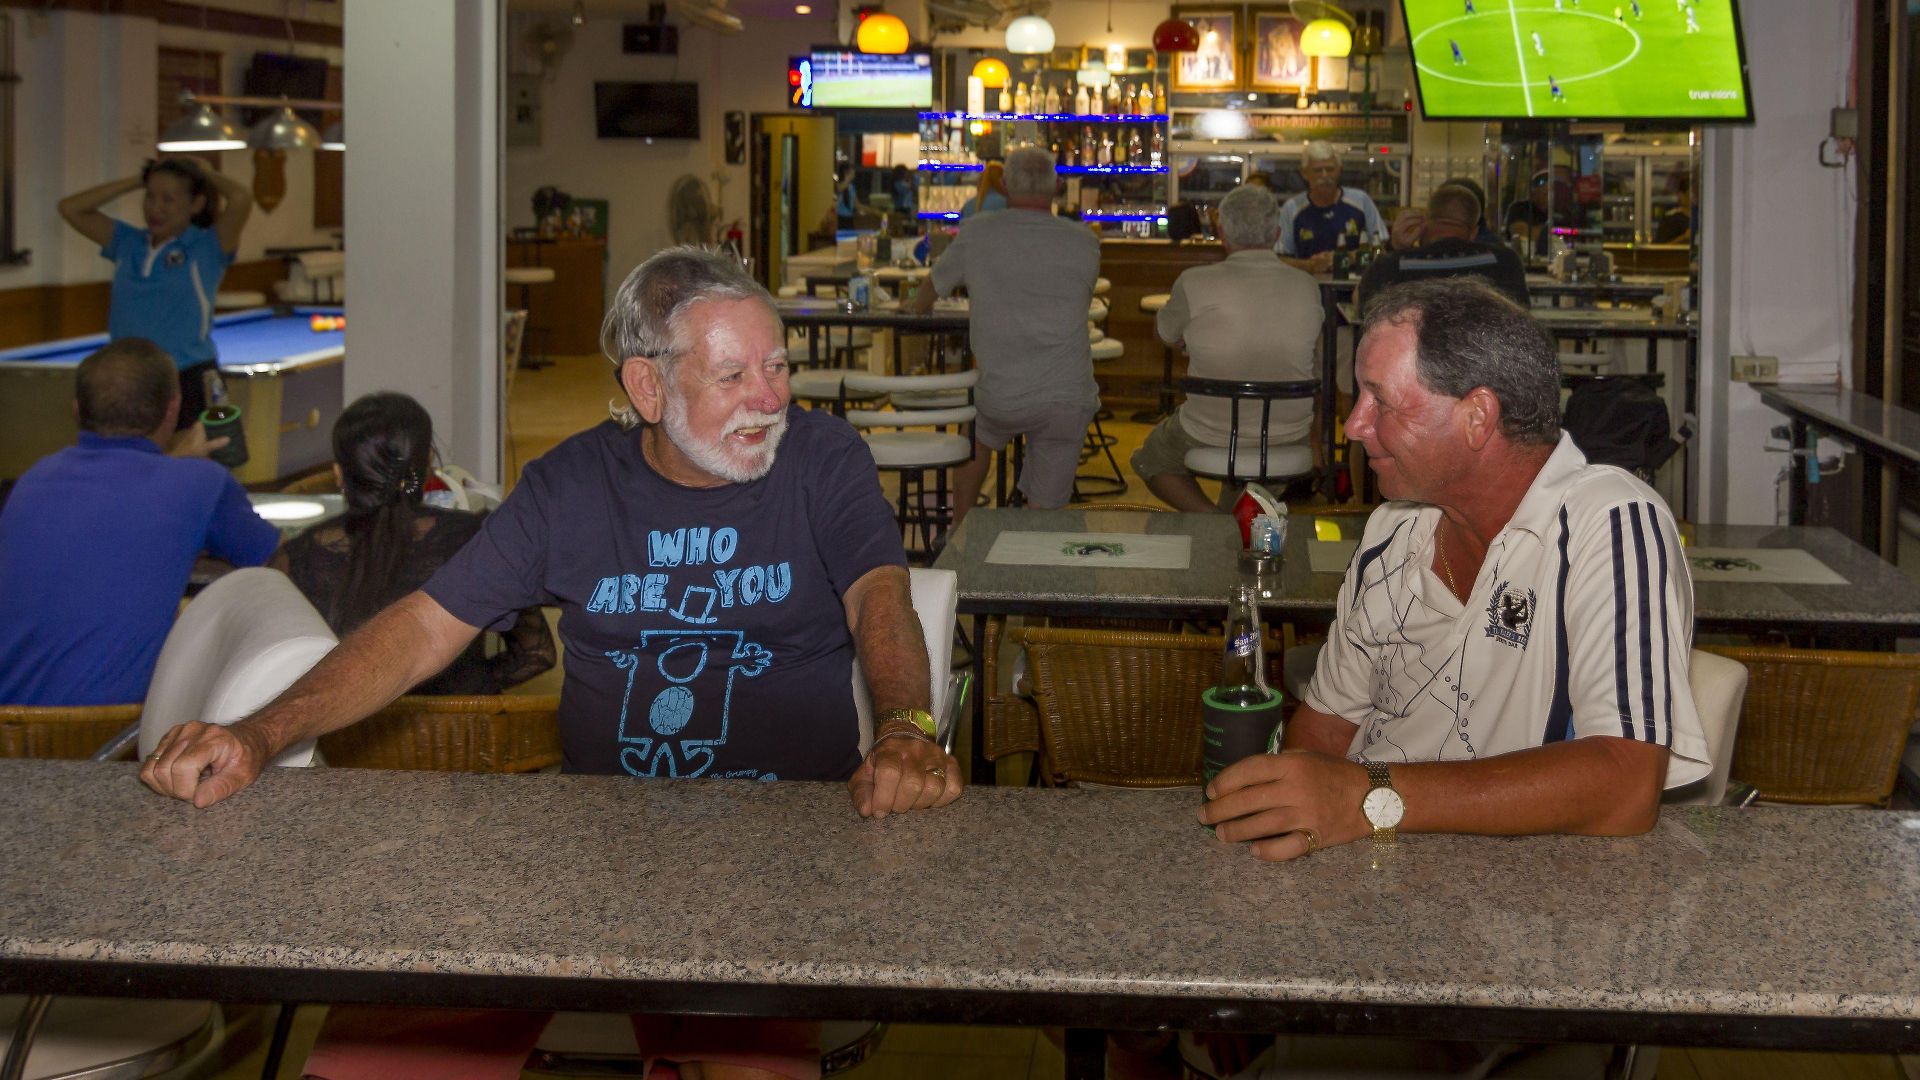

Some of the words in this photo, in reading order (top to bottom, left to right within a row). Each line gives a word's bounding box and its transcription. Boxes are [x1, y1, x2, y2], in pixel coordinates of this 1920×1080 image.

[648, 527, 738, 567] WHO
[587, 573, 669, 614] ARE
[712, 561, 792, 609] YOU
[725, 768, 759, 779] Grumpy
